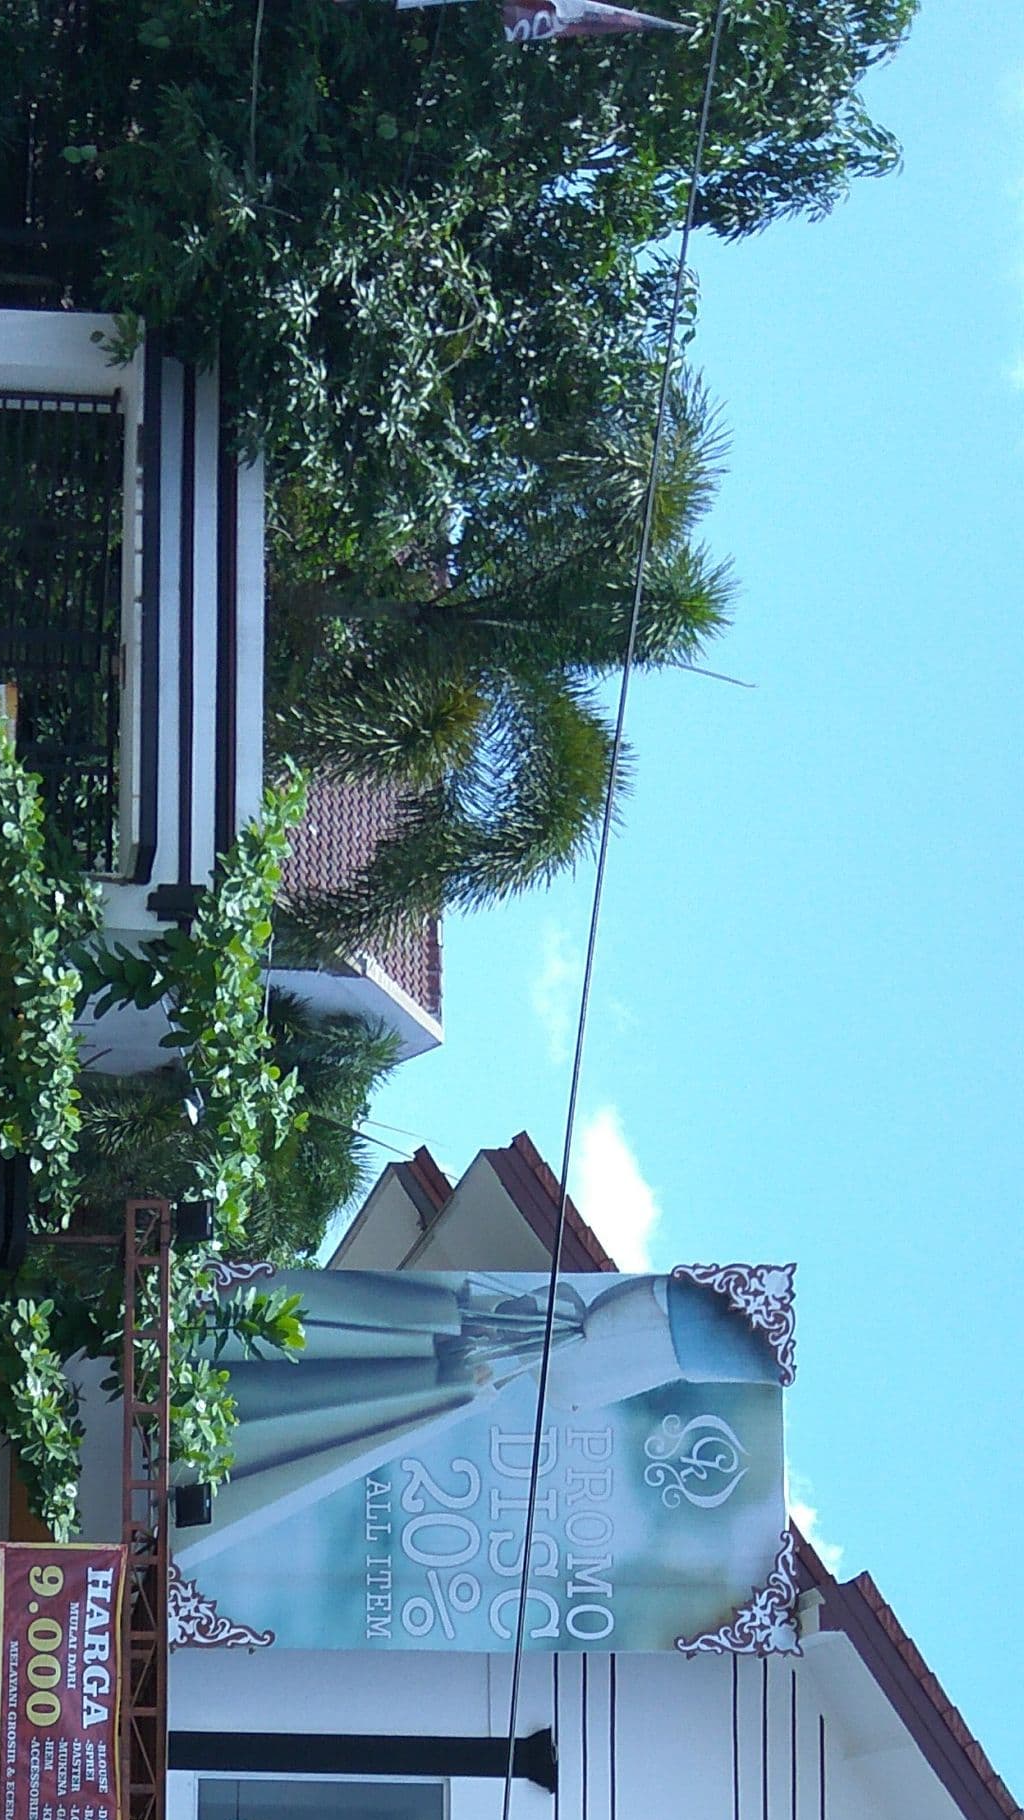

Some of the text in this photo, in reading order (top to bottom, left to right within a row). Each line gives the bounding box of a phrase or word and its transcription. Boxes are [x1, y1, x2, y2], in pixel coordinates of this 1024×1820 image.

[365, 1477, 392, 1638] ALL ITEM
[401, 1457, 482, 1640] 20%
[488, 1425, 559, 1640] DISC
[565, 1425, 614, 1642] PROMO
[6, 1640, 19, 1708] MELAYANI
[26, 1564, 64, 1728] 9.000
[66, 1602, 79, 1689] MULAI DARI
[82, 1567, 114, 1729] HARGA
[5, 1711, 18, 1763] GROSIR
[5, 1767, 16, 1777] &
